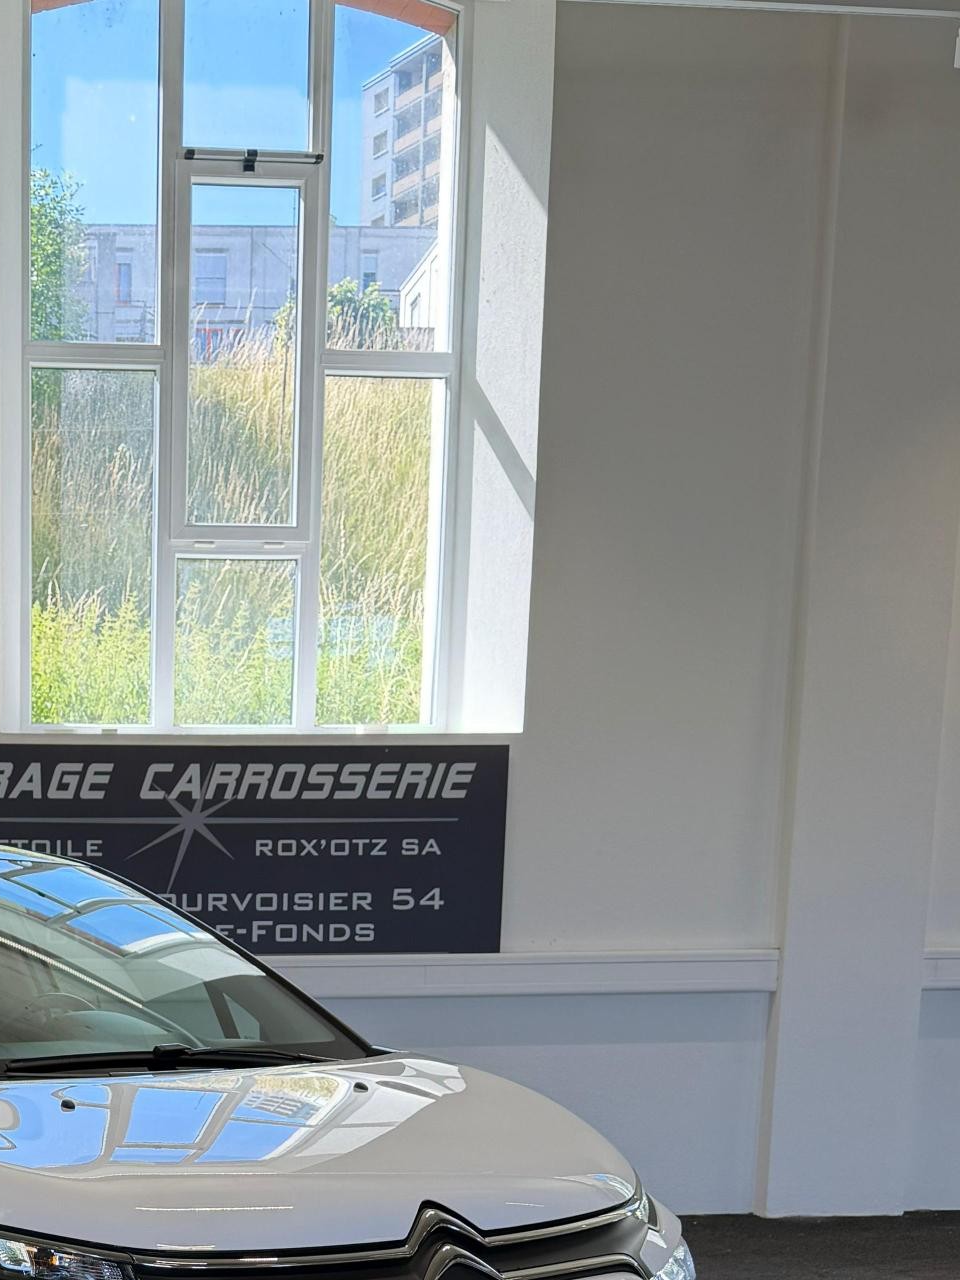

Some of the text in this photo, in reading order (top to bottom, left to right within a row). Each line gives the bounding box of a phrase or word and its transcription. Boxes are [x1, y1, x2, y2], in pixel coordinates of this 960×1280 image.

[139, 762, 477, 800] CARROSSERIE
[255, 838, 442, 857] ROX'OTZ SA
[392, 888, 444, 911] 54
